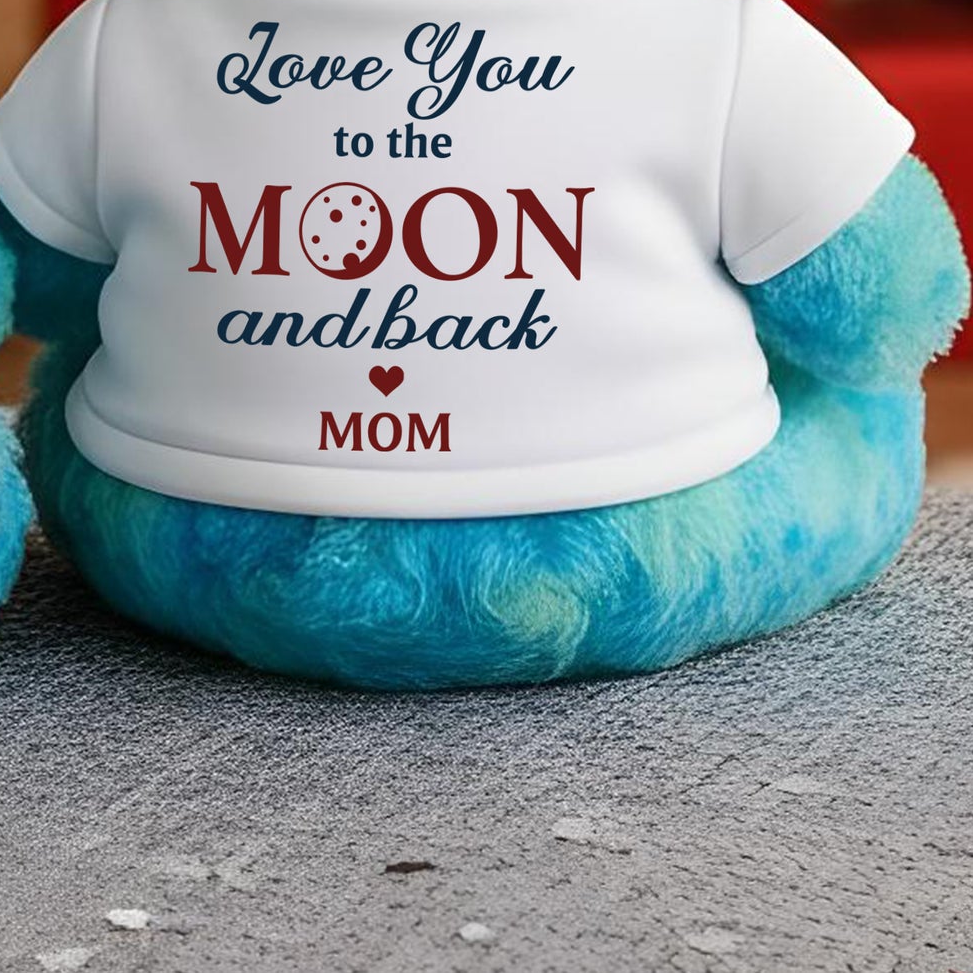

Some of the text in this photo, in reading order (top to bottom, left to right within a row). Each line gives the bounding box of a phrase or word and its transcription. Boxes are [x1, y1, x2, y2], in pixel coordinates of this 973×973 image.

[217, 21, 575, 120] Love You
[333, 122, 453, 159] to the
[188, 181, 595, 281] MOON
[217, 284, 558, 350] and back
[318, 411, 452, 452] MOM
